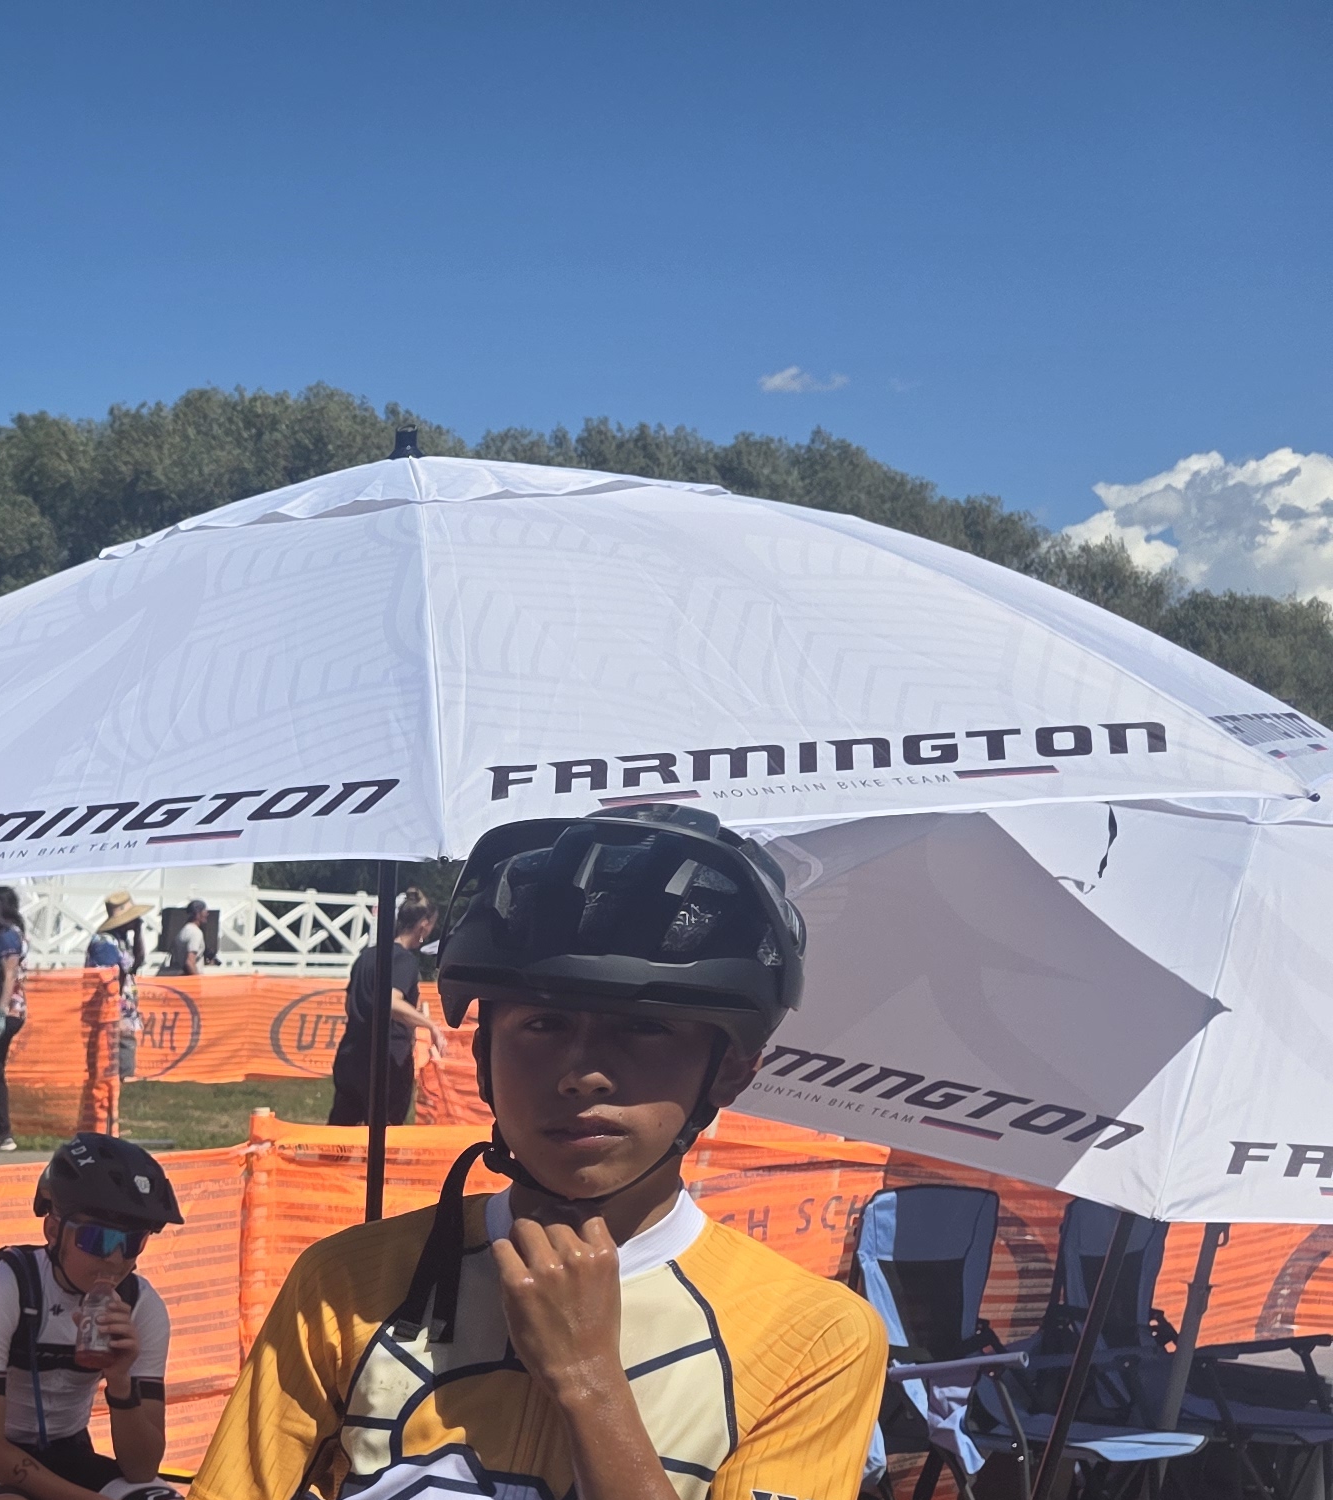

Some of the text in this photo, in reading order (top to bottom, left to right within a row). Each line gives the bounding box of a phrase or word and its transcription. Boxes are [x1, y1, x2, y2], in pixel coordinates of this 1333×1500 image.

[484, 722, 1167, 801] FARMINGTON
[713, 773, 951, 799] MOUNTAIN BIKE TEAM
[37, 845, 77, 857] BIKE
[89, 839, 138, 852] TEAM
[139, 1012, 180, 1051] AH
[296, 1014, 348, 1051] UT
[752, 1081, 915, 1124] OUNTAIN BIKE TEAM
[762, 1045, 1144, 1150] MINGTON
[795, 1195, 868, 1234] SCH
